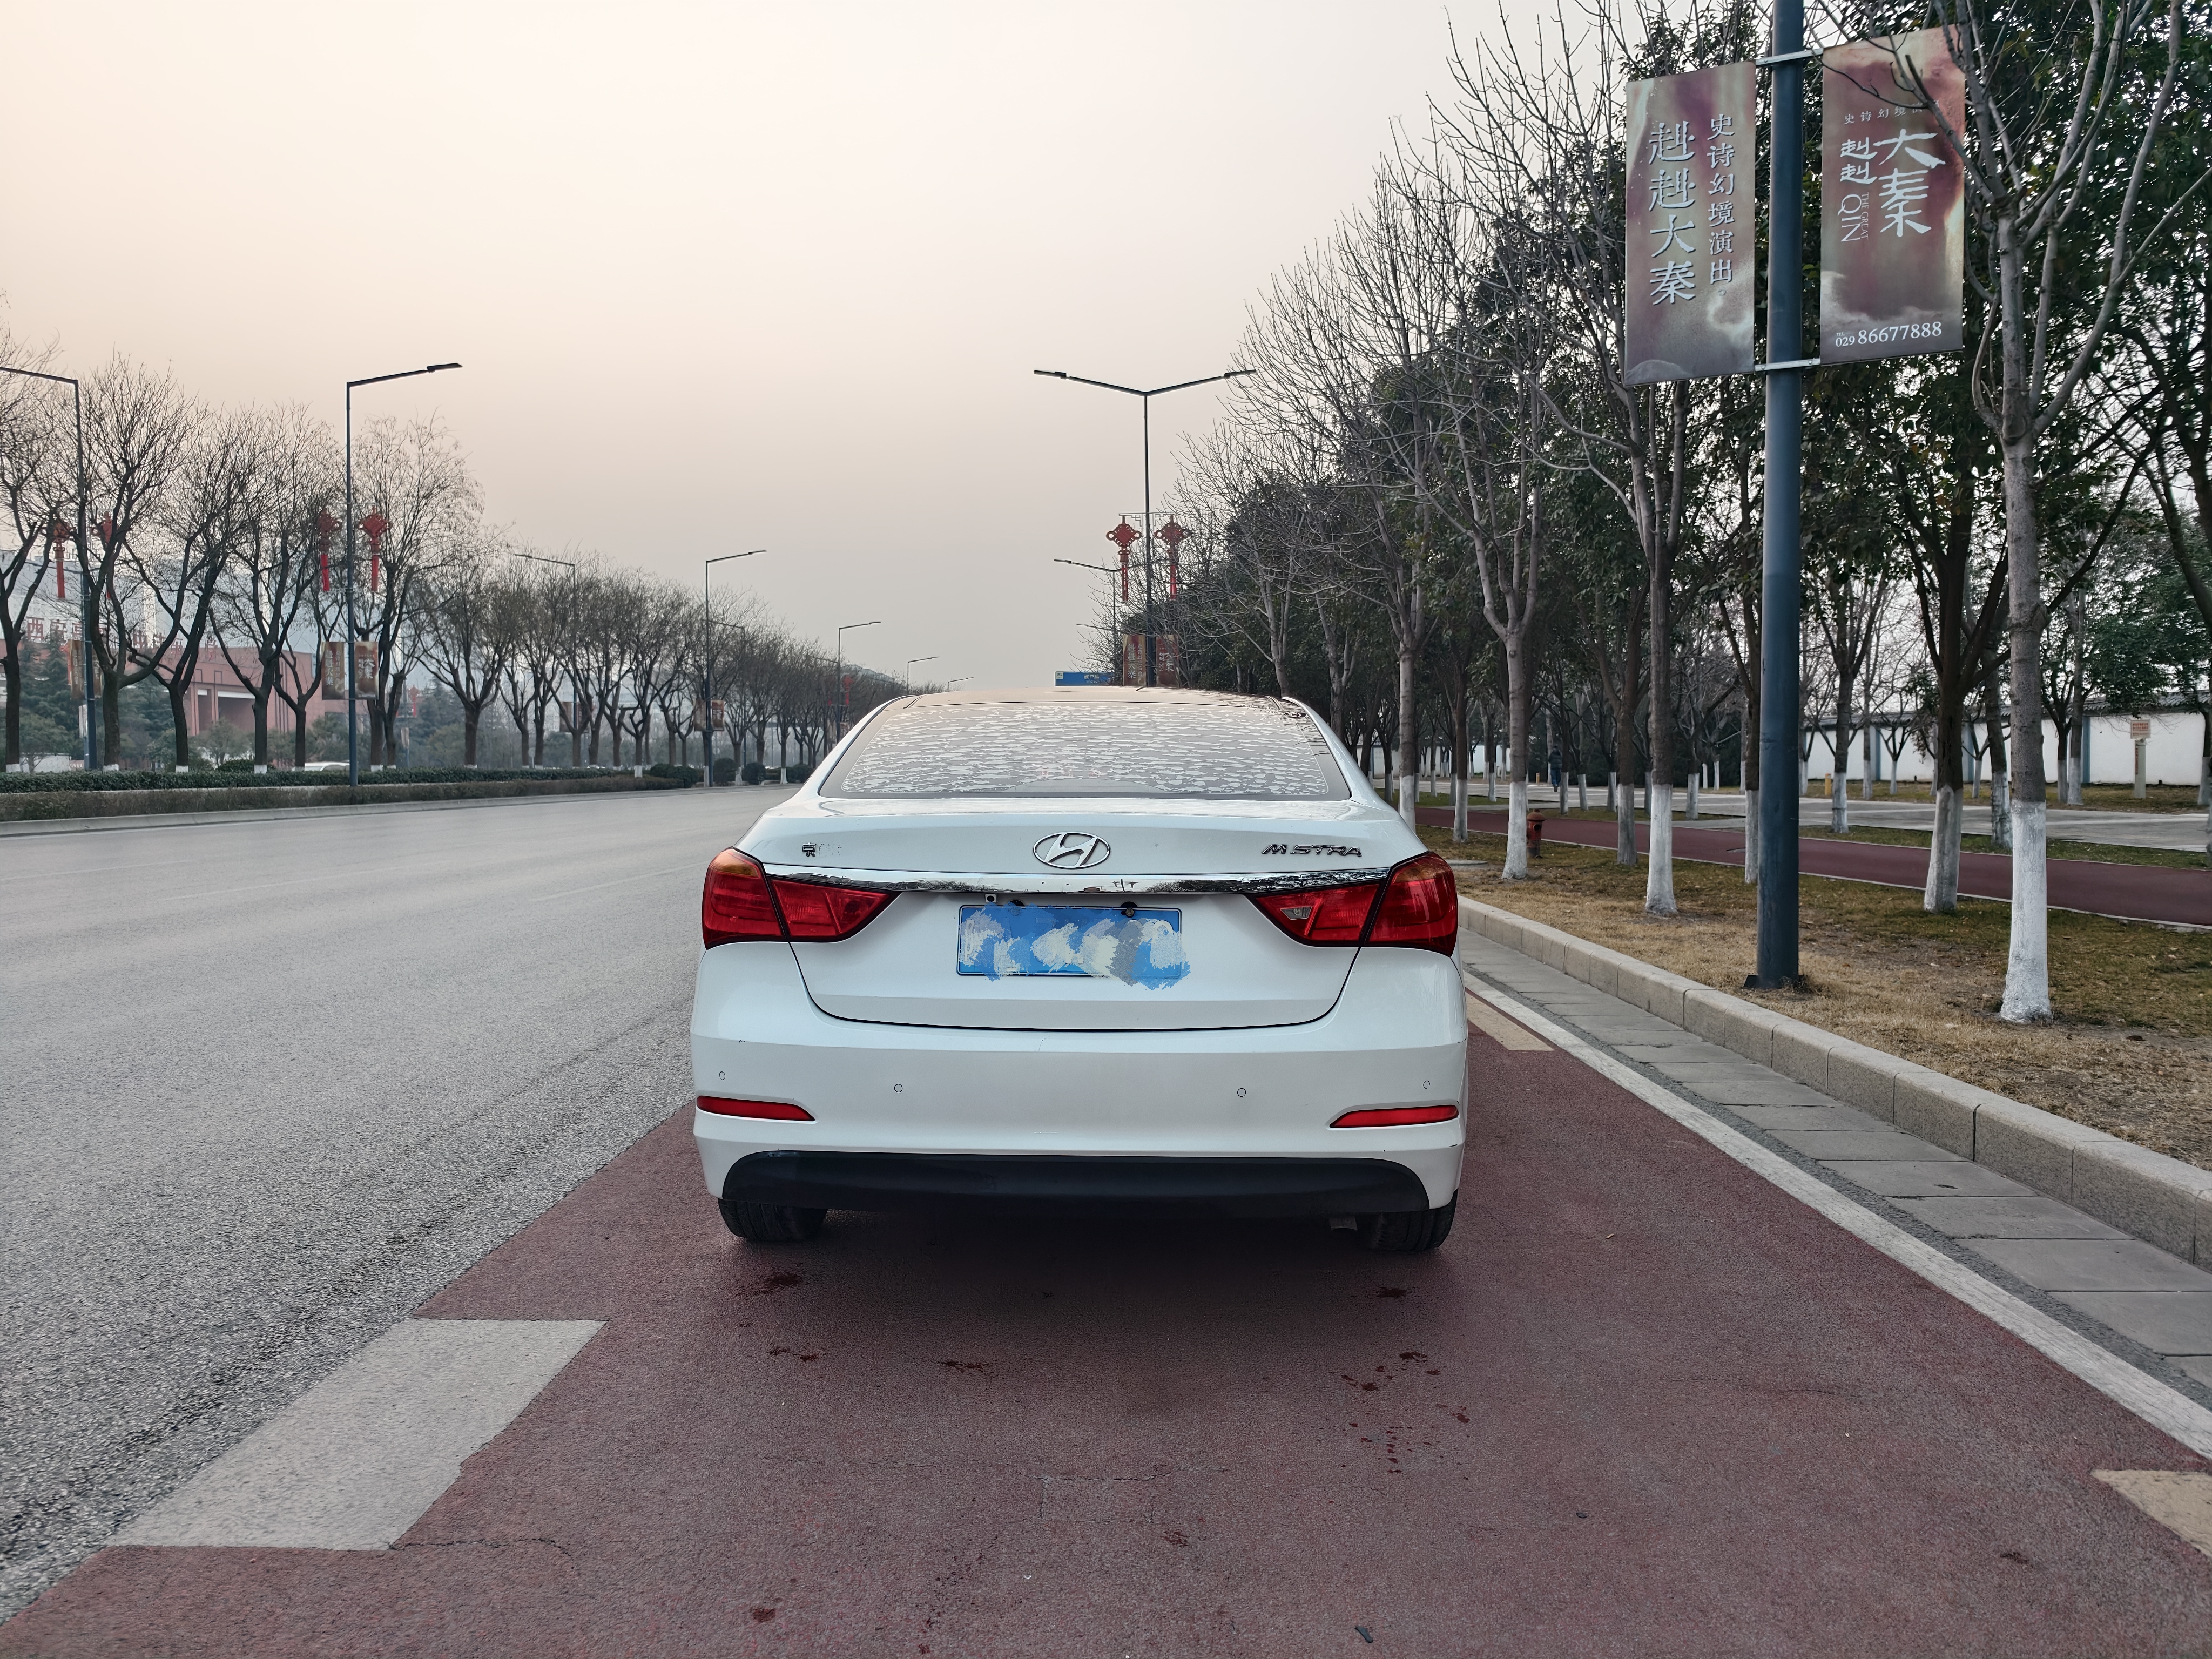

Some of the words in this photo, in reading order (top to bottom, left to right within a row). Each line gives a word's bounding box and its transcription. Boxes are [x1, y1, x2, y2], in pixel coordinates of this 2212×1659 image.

[1840, 137, 1878, 184] 赳赳
[1873, 129, 1946, 237] 大秦
[1649, 120, 1696, 306] 赳赳大秦
[1707, 113, 1735, 285] 史诗幻境演出
[1837, 194, 1862, 242] QIN
[1861, 192, 1869, 208] THE
[1860, 211, 1869, 240] GREAT
[1836, 336, 1855, 347] 029
[1858, 321, 1942, 345] 86677888
